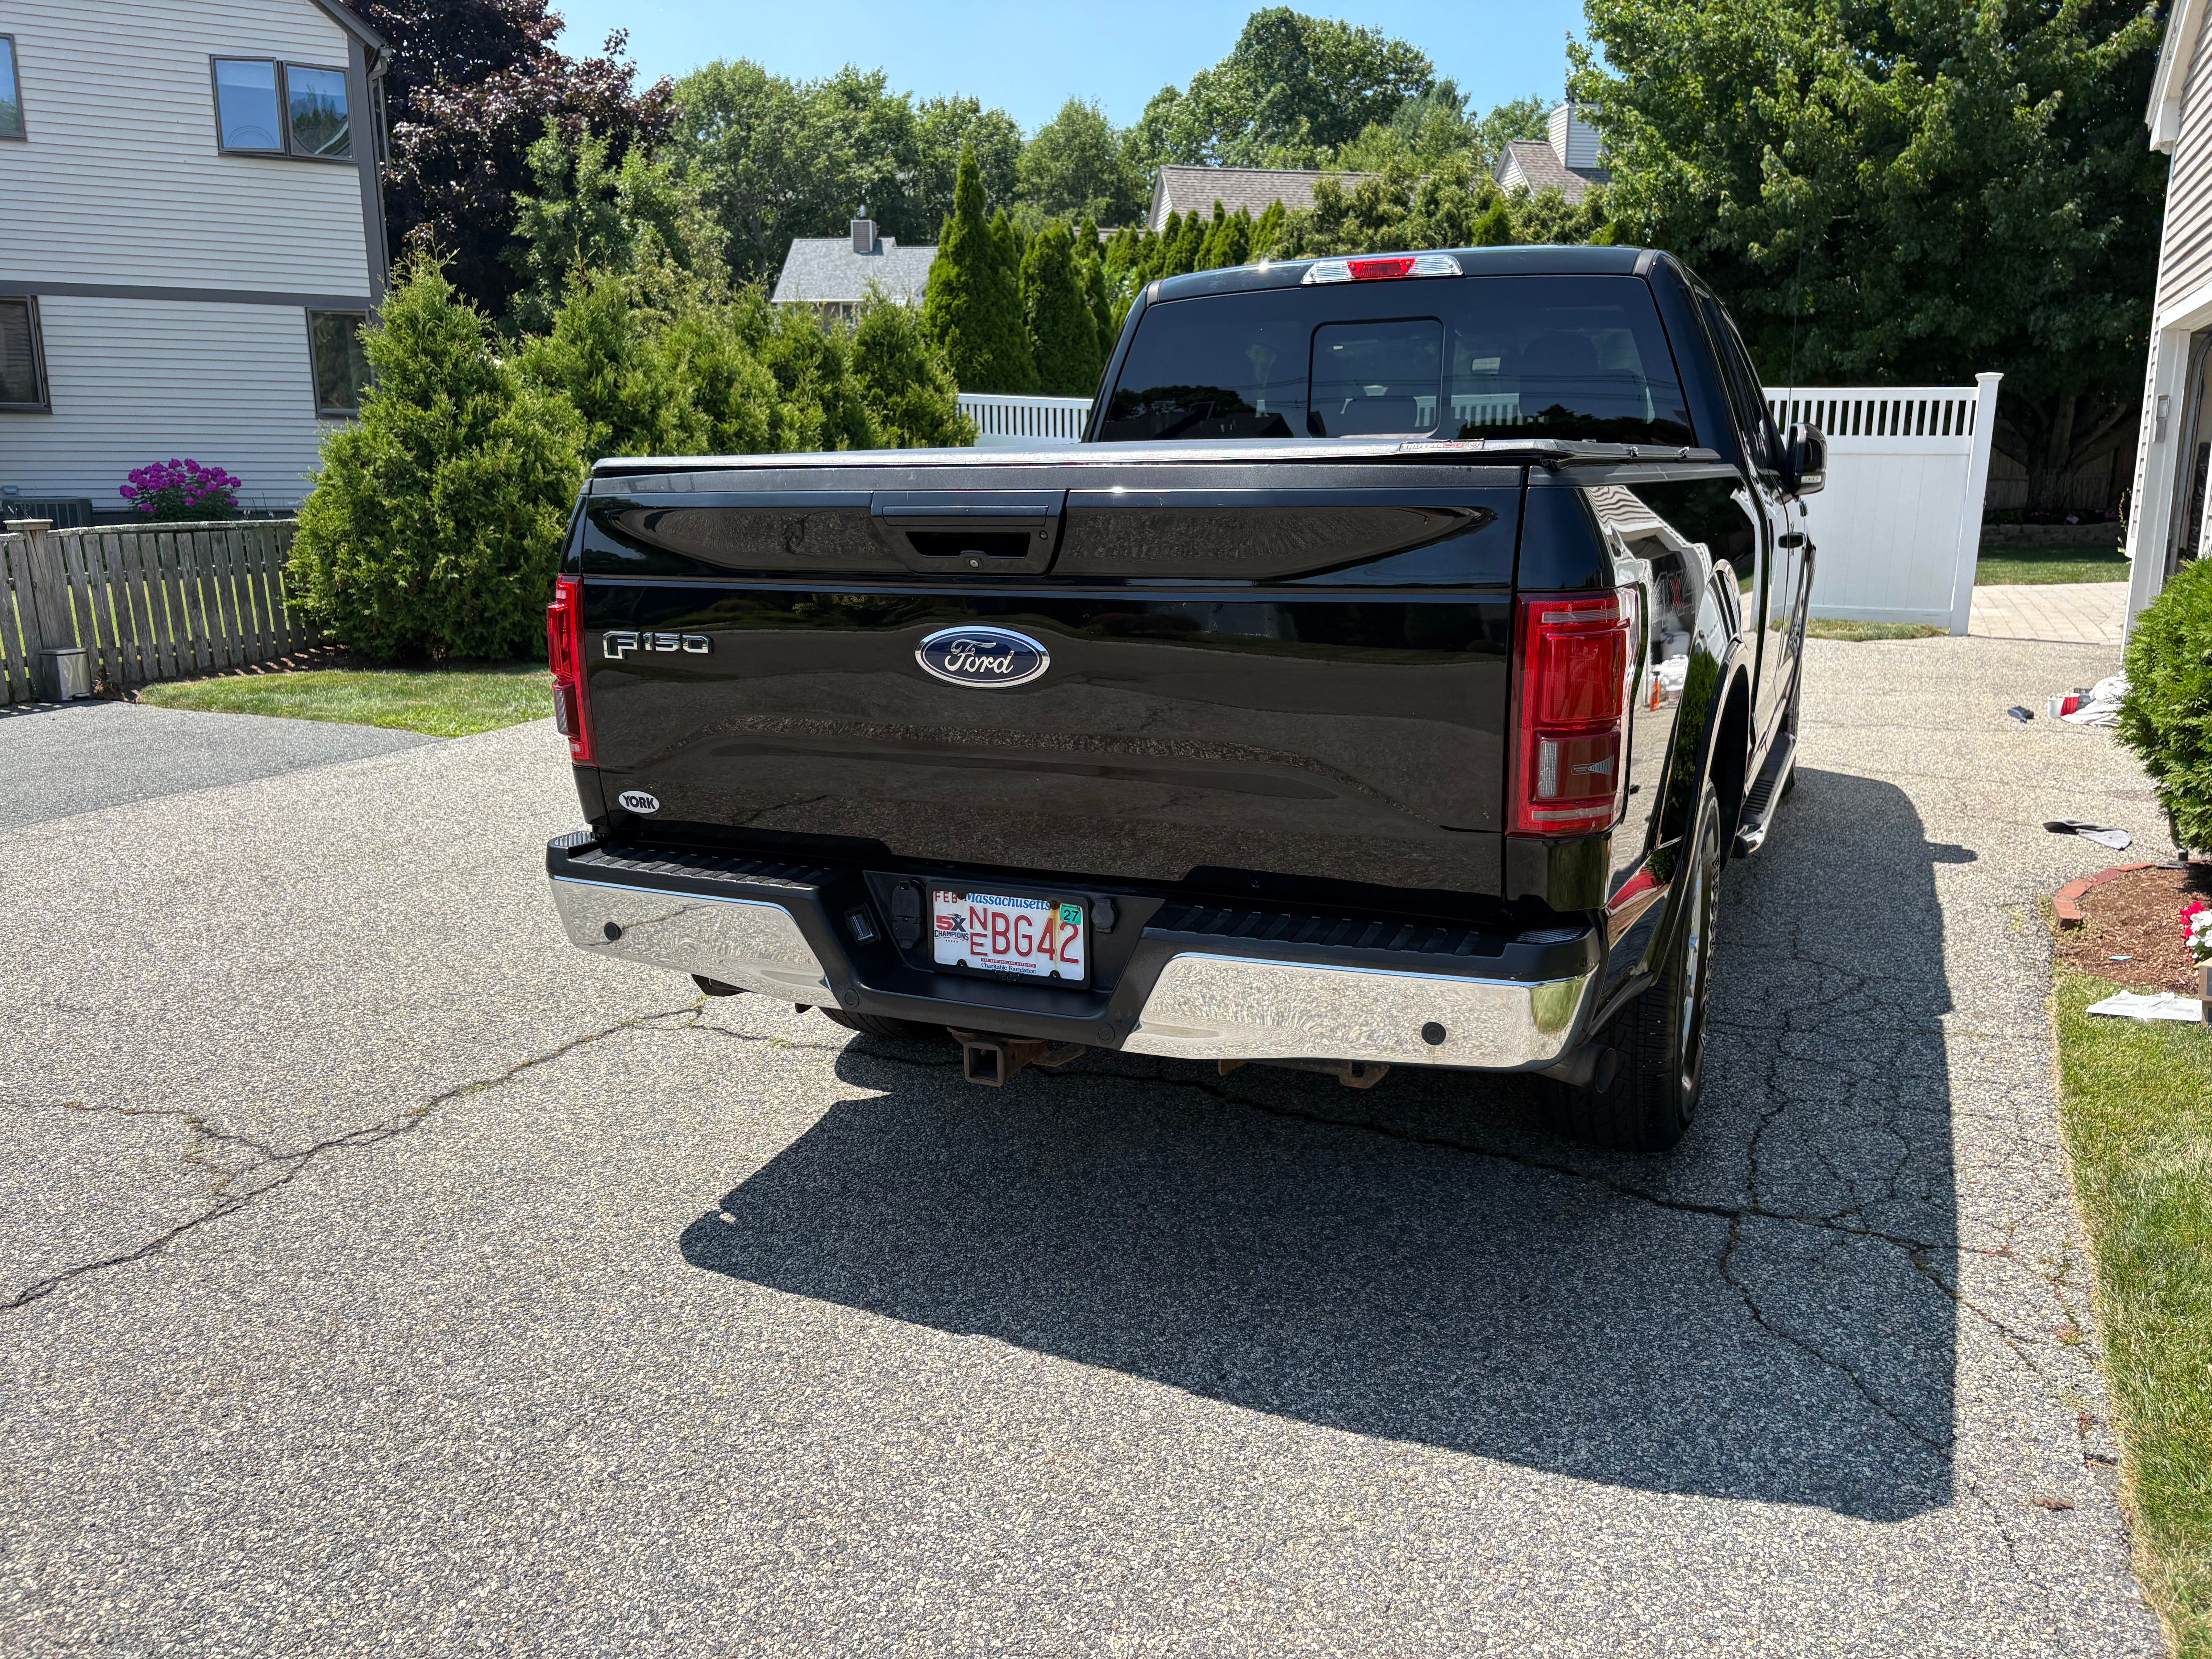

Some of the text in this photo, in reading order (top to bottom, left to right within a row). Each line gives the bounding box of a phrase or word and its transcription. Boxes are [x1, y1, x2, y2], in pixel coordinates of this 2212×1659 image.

[945, 639, 1014, 674] Ford
[622, 795, 656, 809] YORK
[935, 891, 957, 903] FEB
[964, 893, 1051, 911] Massachusetts
[1064, 909, 1079, 921] 27
[936, 915, 967, 932] 5X
[934, 930, 969, 941] CHAMPIONS
